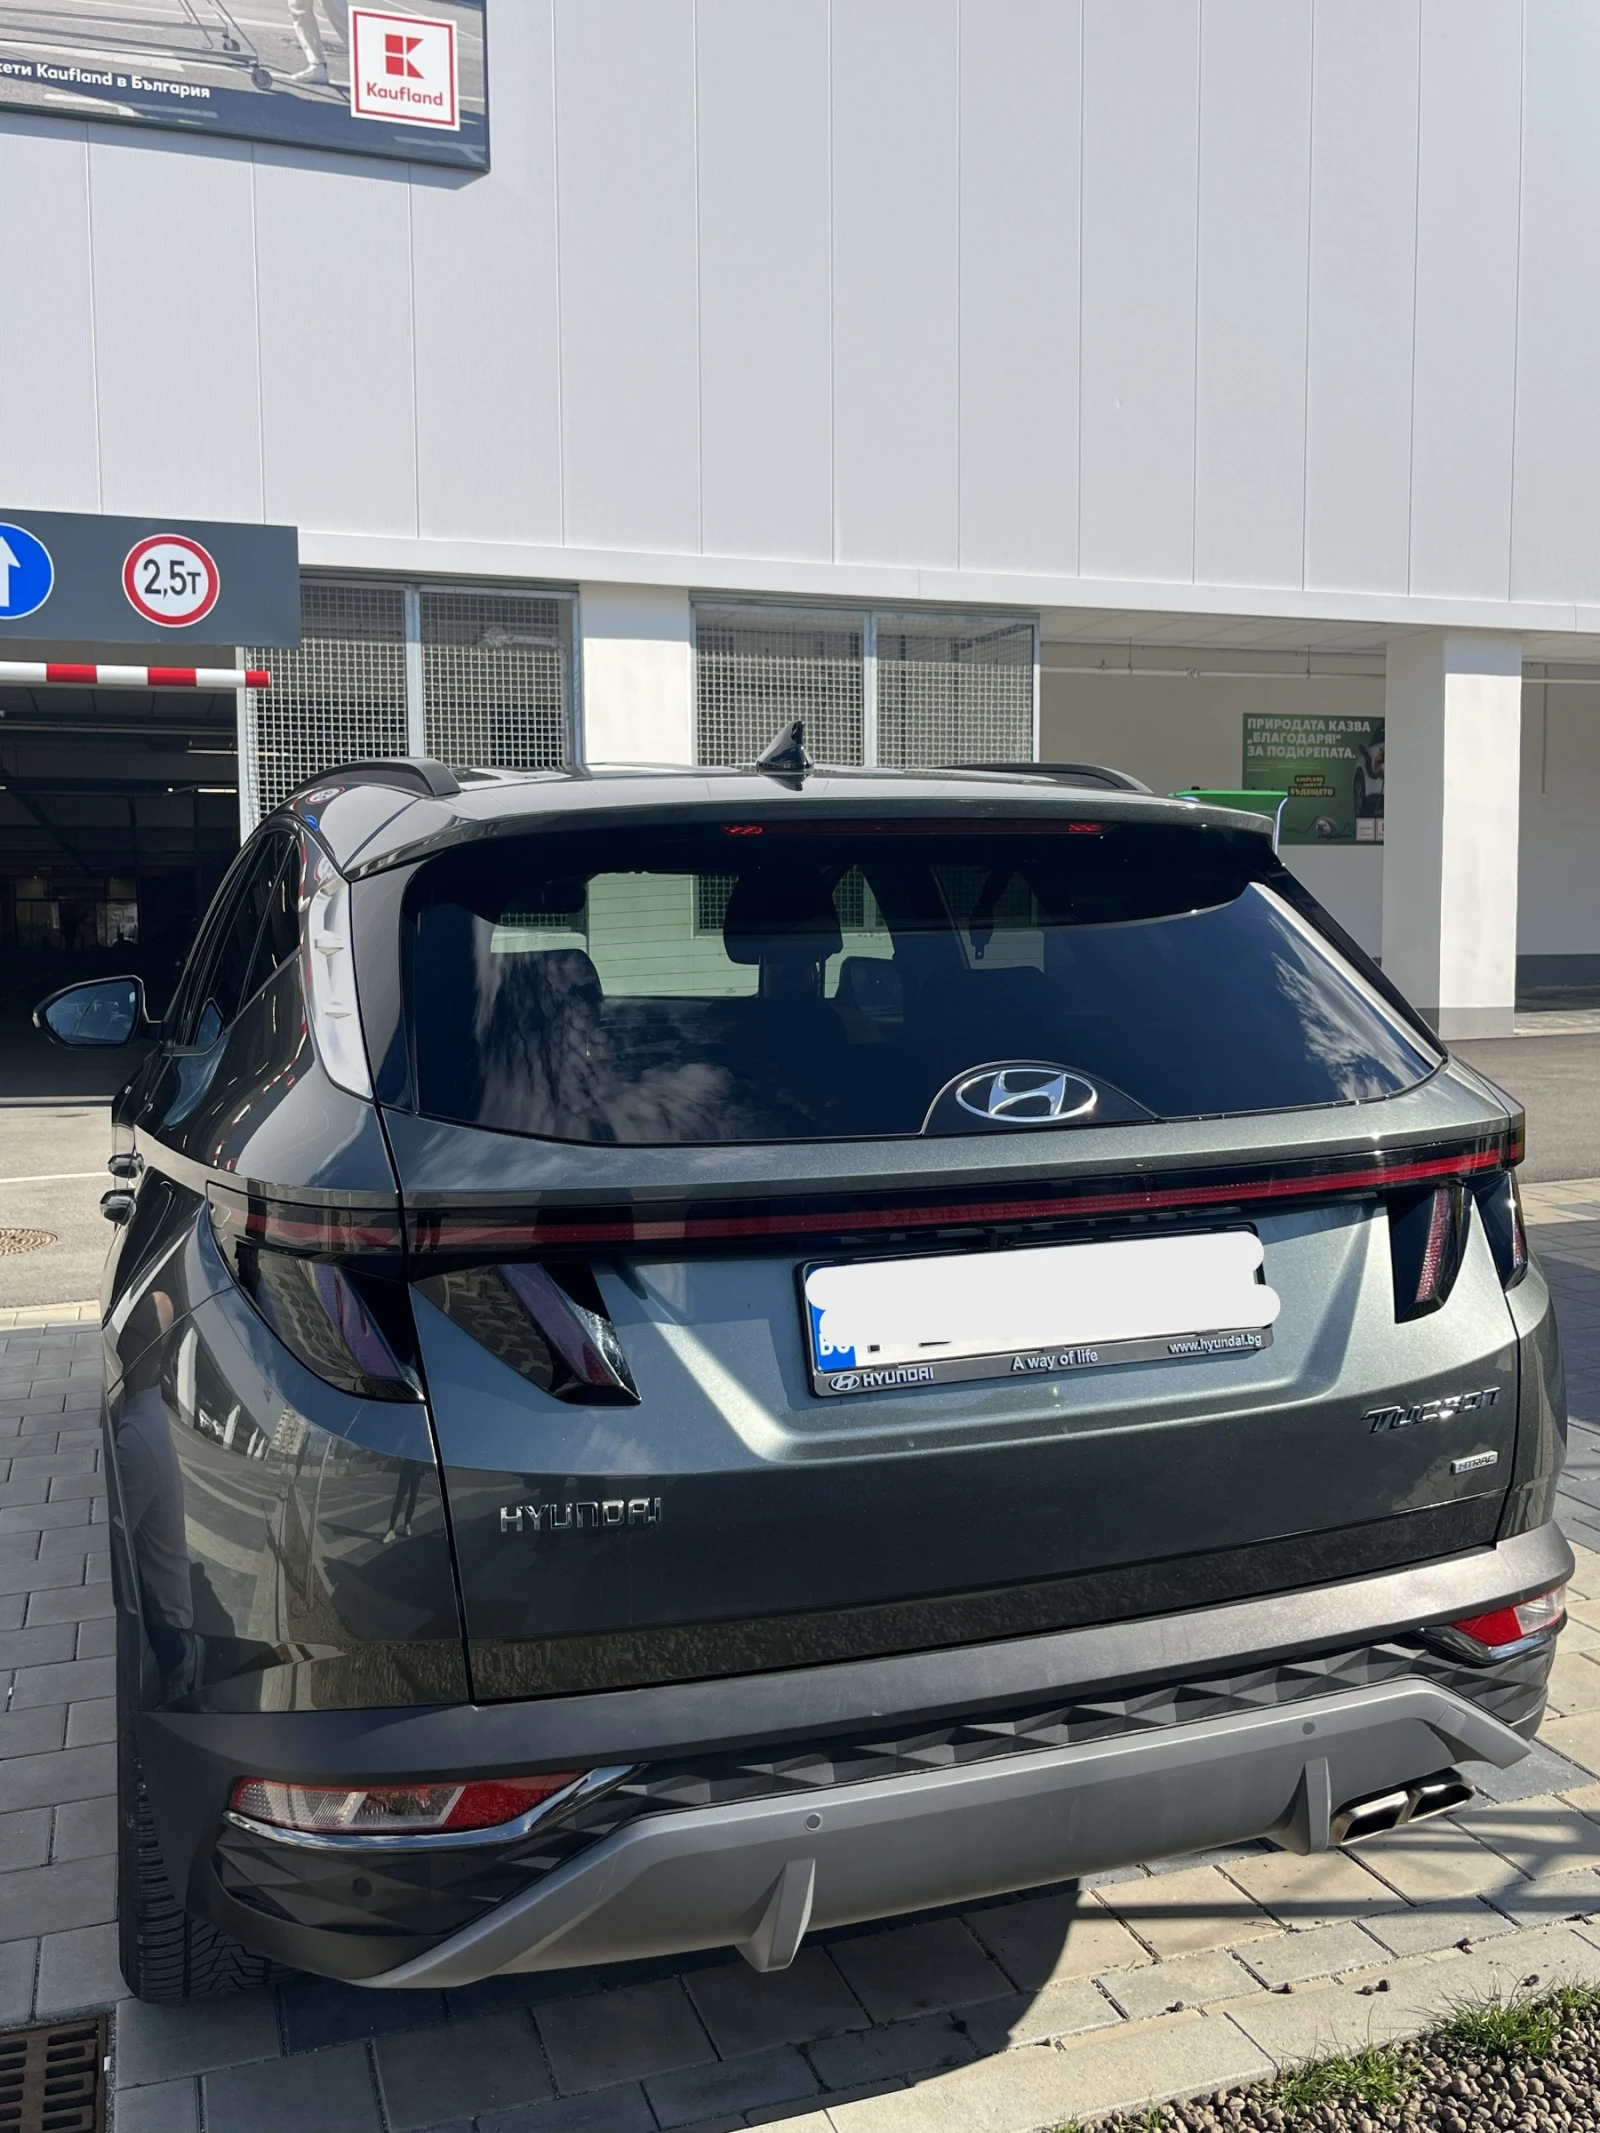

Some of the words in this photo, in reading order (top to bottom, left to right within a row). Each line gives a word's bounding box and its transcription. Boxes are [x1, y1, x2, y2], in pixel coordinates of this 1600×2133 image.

[37, 63, 112, 87] Kaufland
[117, 76, 127, 88] в
[131, 75, 211, 99] България
[366, 81, 444, 107] Kaufland
[1247, 718, 1325, 731] ПРИРОДАТА
[1329, 720, 1371, 732] КАЗВА
[1247, 745, 1264, 757] ЗА
[1267, 746, 1356, 759] ПОДКРЕПАТА.
[862, 1367, 934, 1388] HYUNDAI
[1011, 1356, 1025, 1371] A
[1028, 1356, 1056, 1371] way
[1060, 1352, 1074, 1367] of
[1077, 1350, 1100, 1365] life
[1167, 1334, 1263, 1355] www.hyundai.bg
[1360, 1387, 1502, 1434] TUCSON
[1458, 1455, 1495, 1471] HTRAC
[500, 1497, 662, 1533] HYUNDAI
